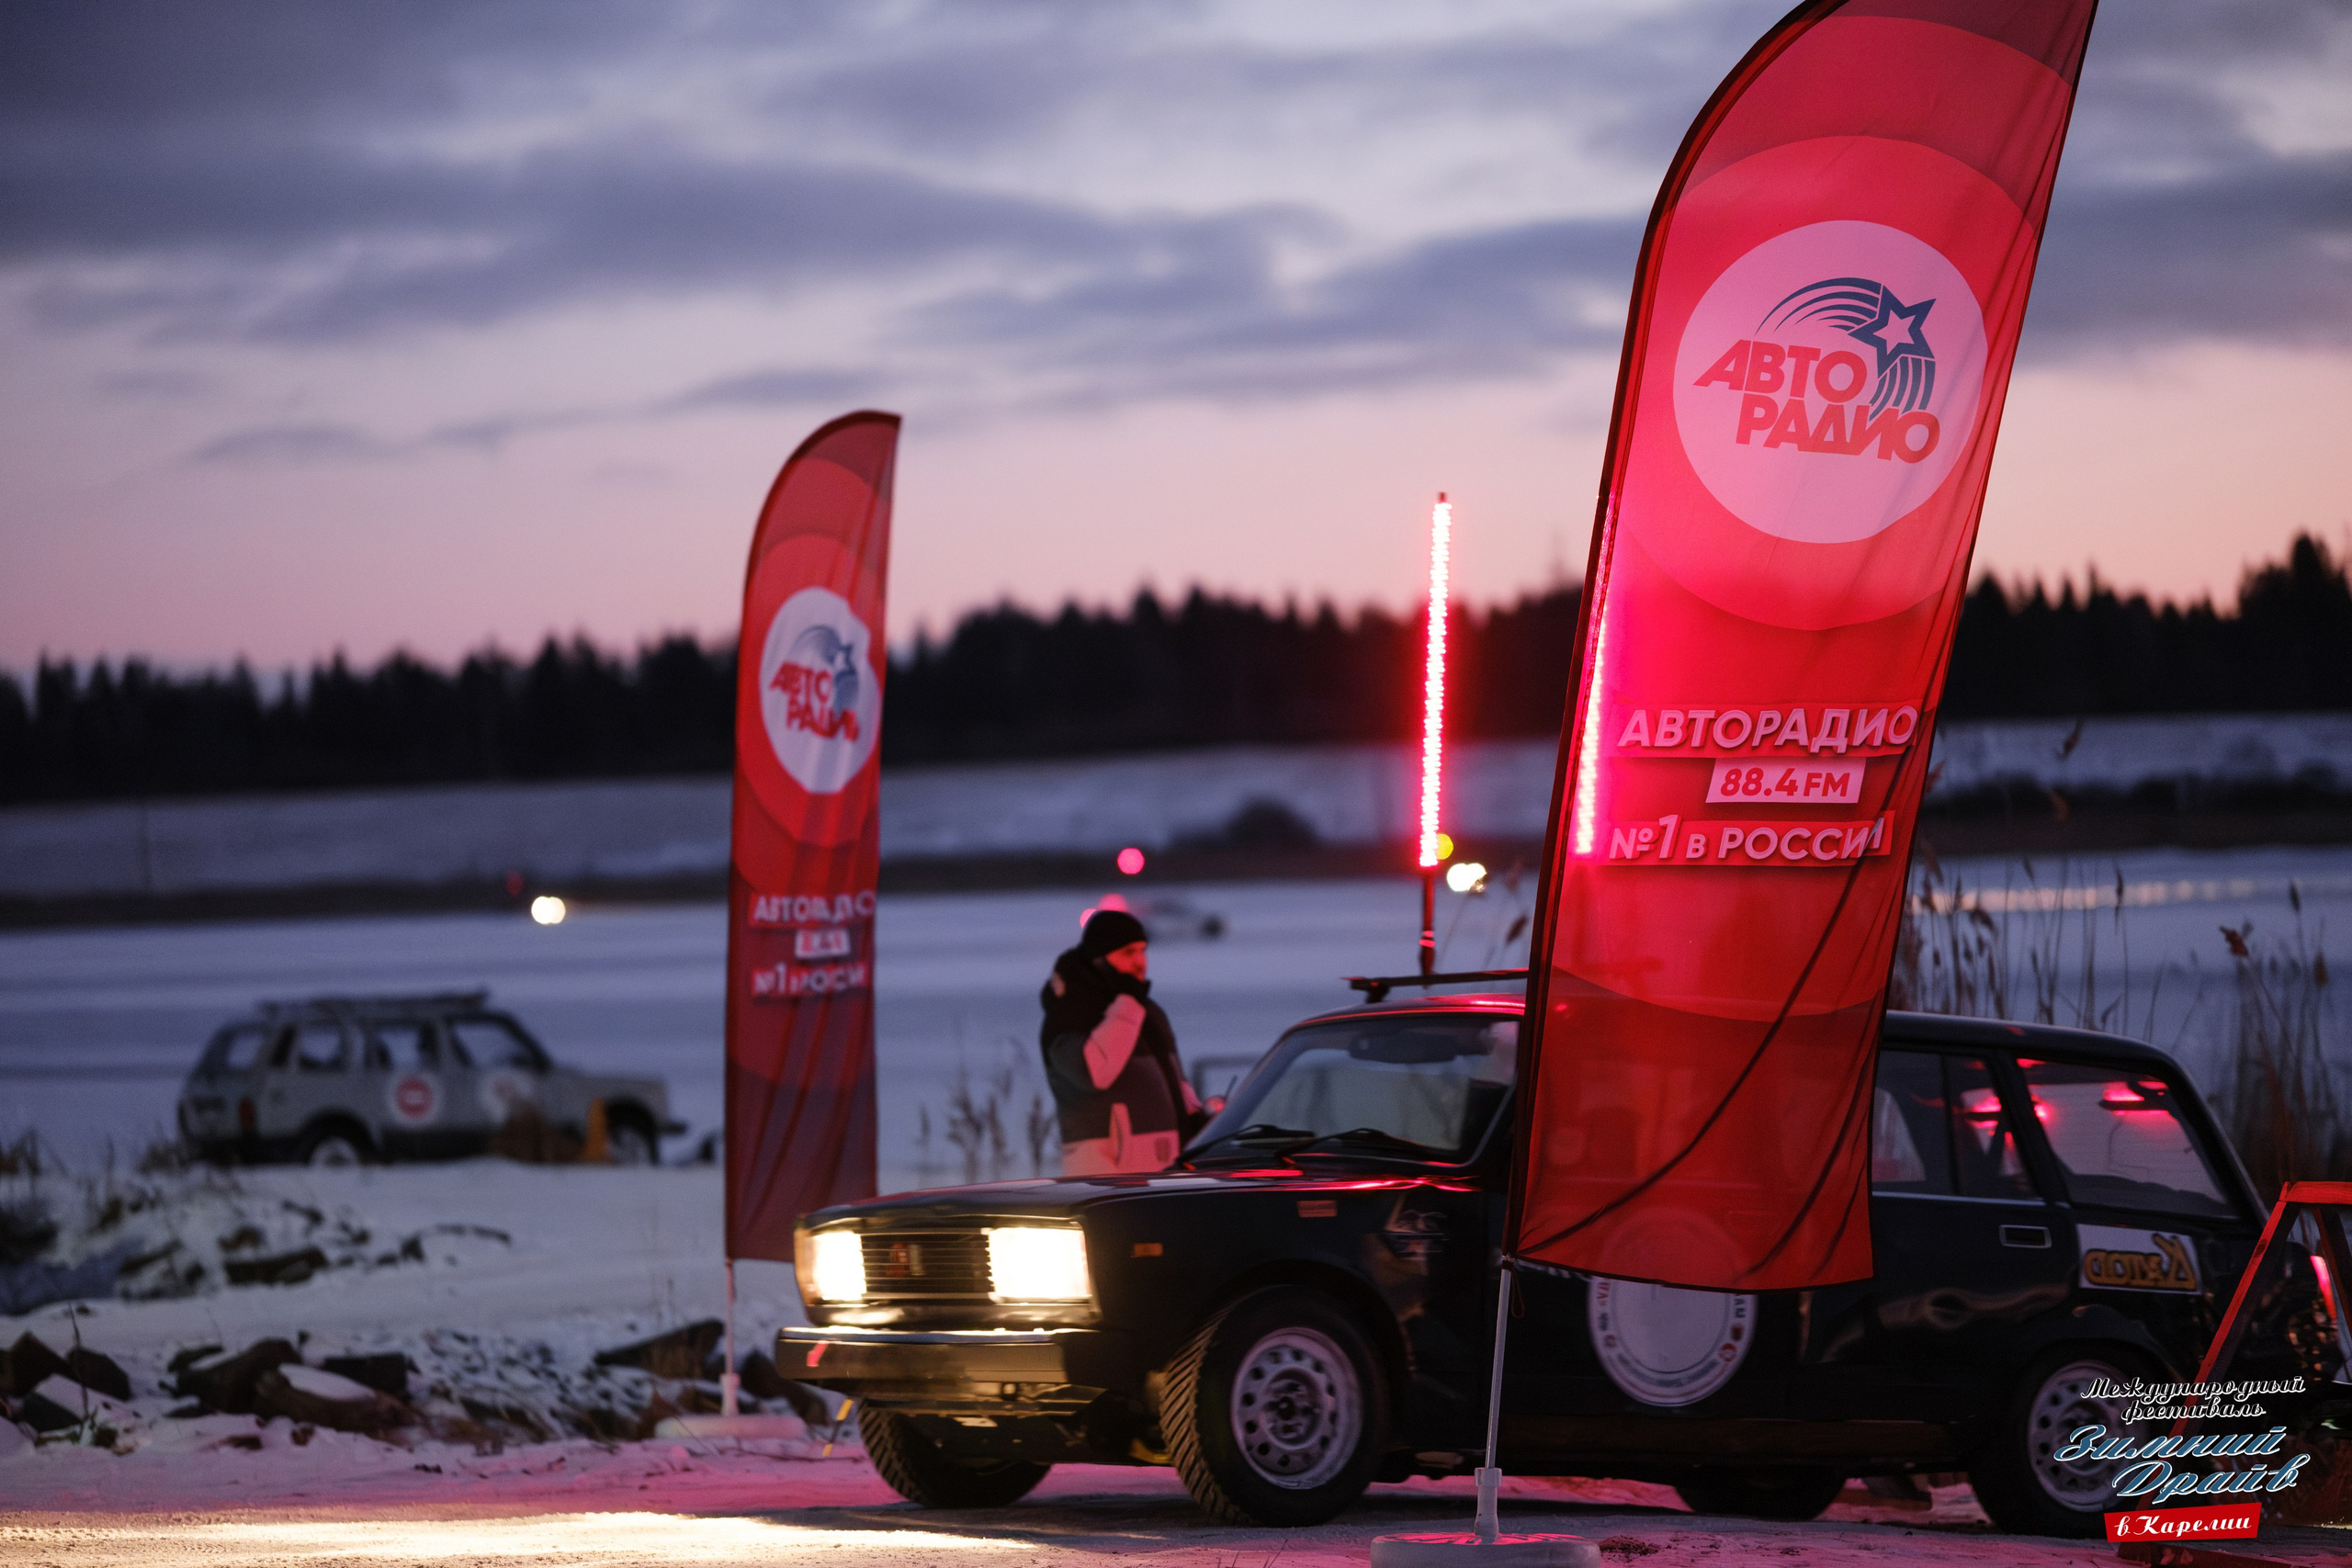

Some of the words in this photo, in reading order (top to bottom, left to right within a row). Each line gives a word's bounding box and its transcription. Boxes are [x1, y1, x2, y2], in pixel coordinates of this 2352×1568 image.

[1692, 339, 1868, 404] АВТО
[1736, 392, 1940, 464] РАДИО
[1617, 705, 1918, 754] АВТОРАДИО
[1720, 767, 1799, 797] 88.4
